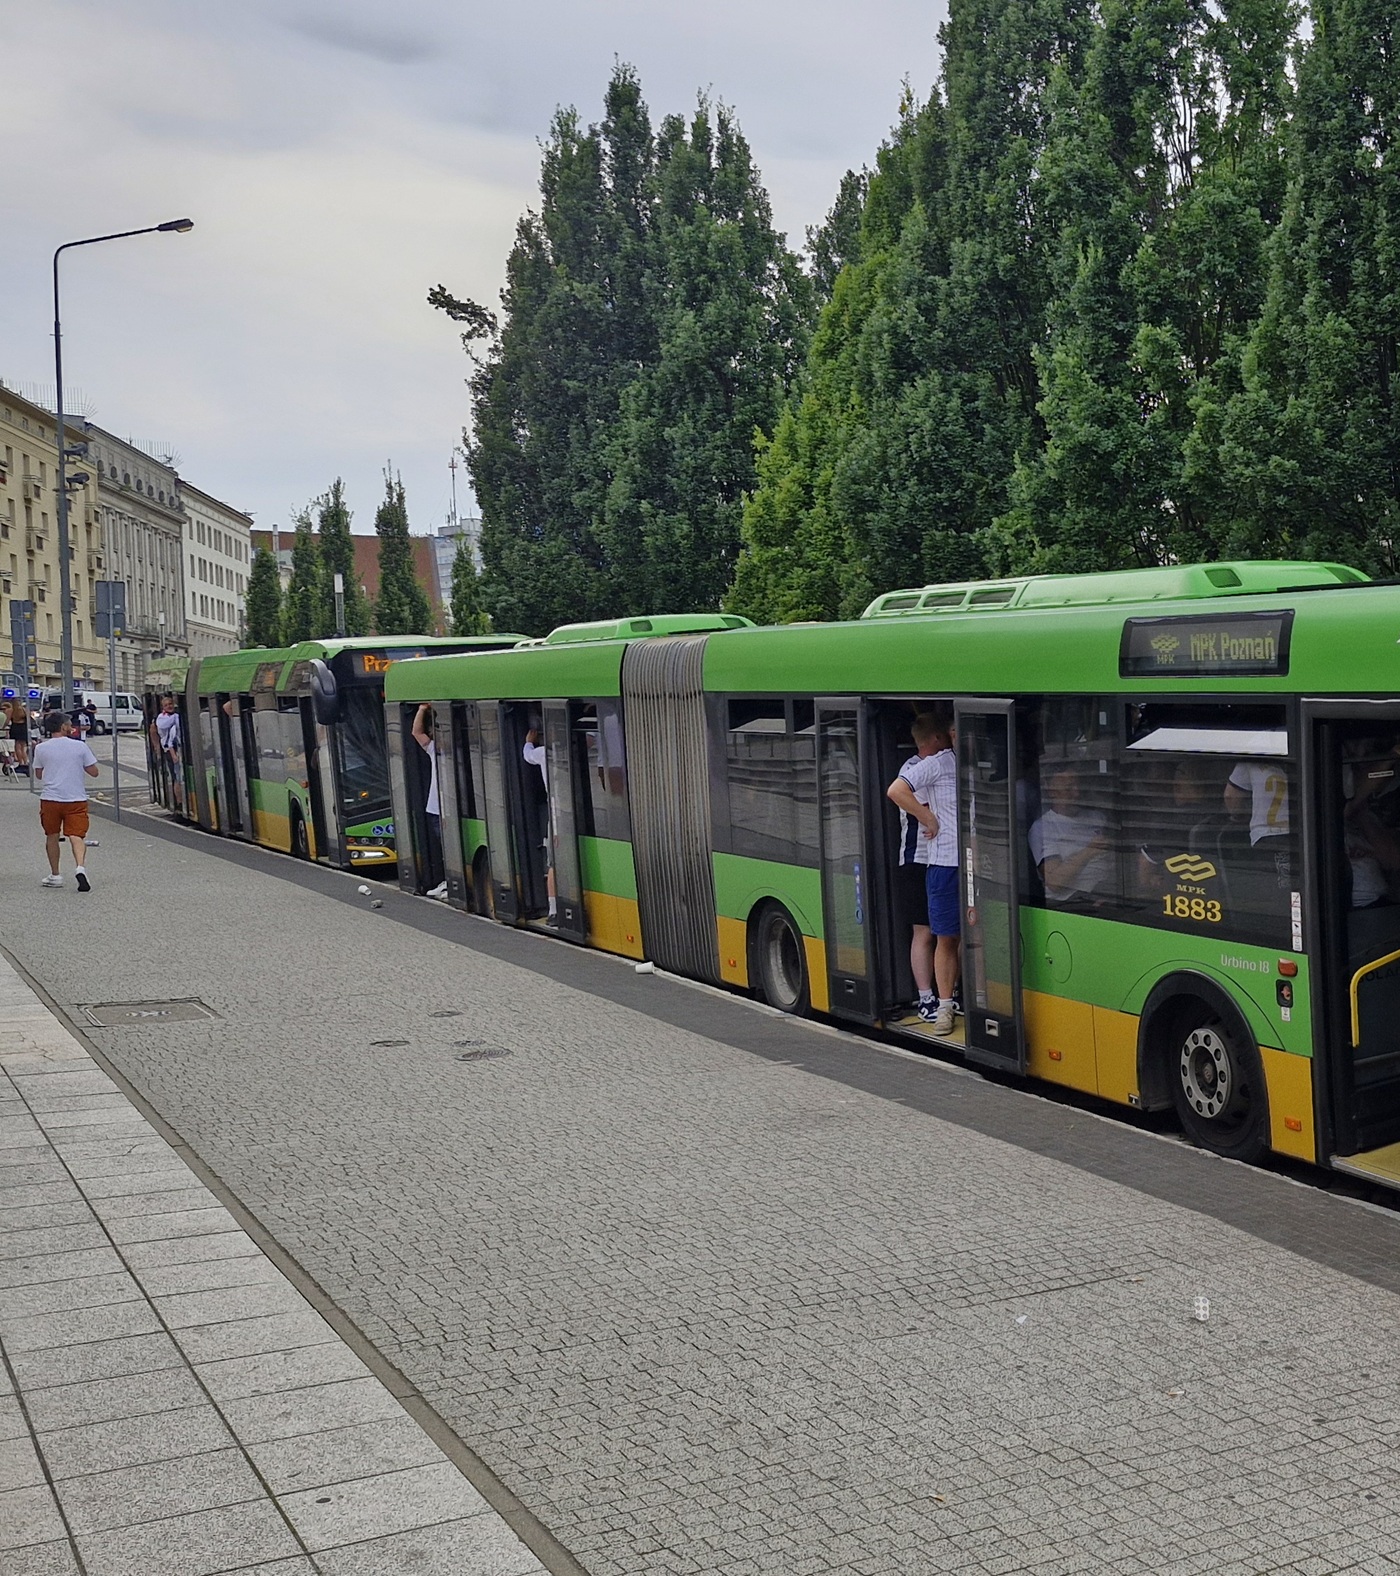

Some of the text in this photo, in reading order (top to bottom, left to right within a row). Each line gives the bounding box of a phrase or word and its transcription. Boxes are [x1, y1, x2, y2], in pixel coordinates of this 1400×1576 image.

[1190, 630, 1276, 662] MPK Poznań
[1156, 654, 1175, 664] MPK
[1176, 883, 1206, 895] MPK
[1162, 893, 1222, 922] 1883
[1220, 953, 1270, 974] Urbino 18
